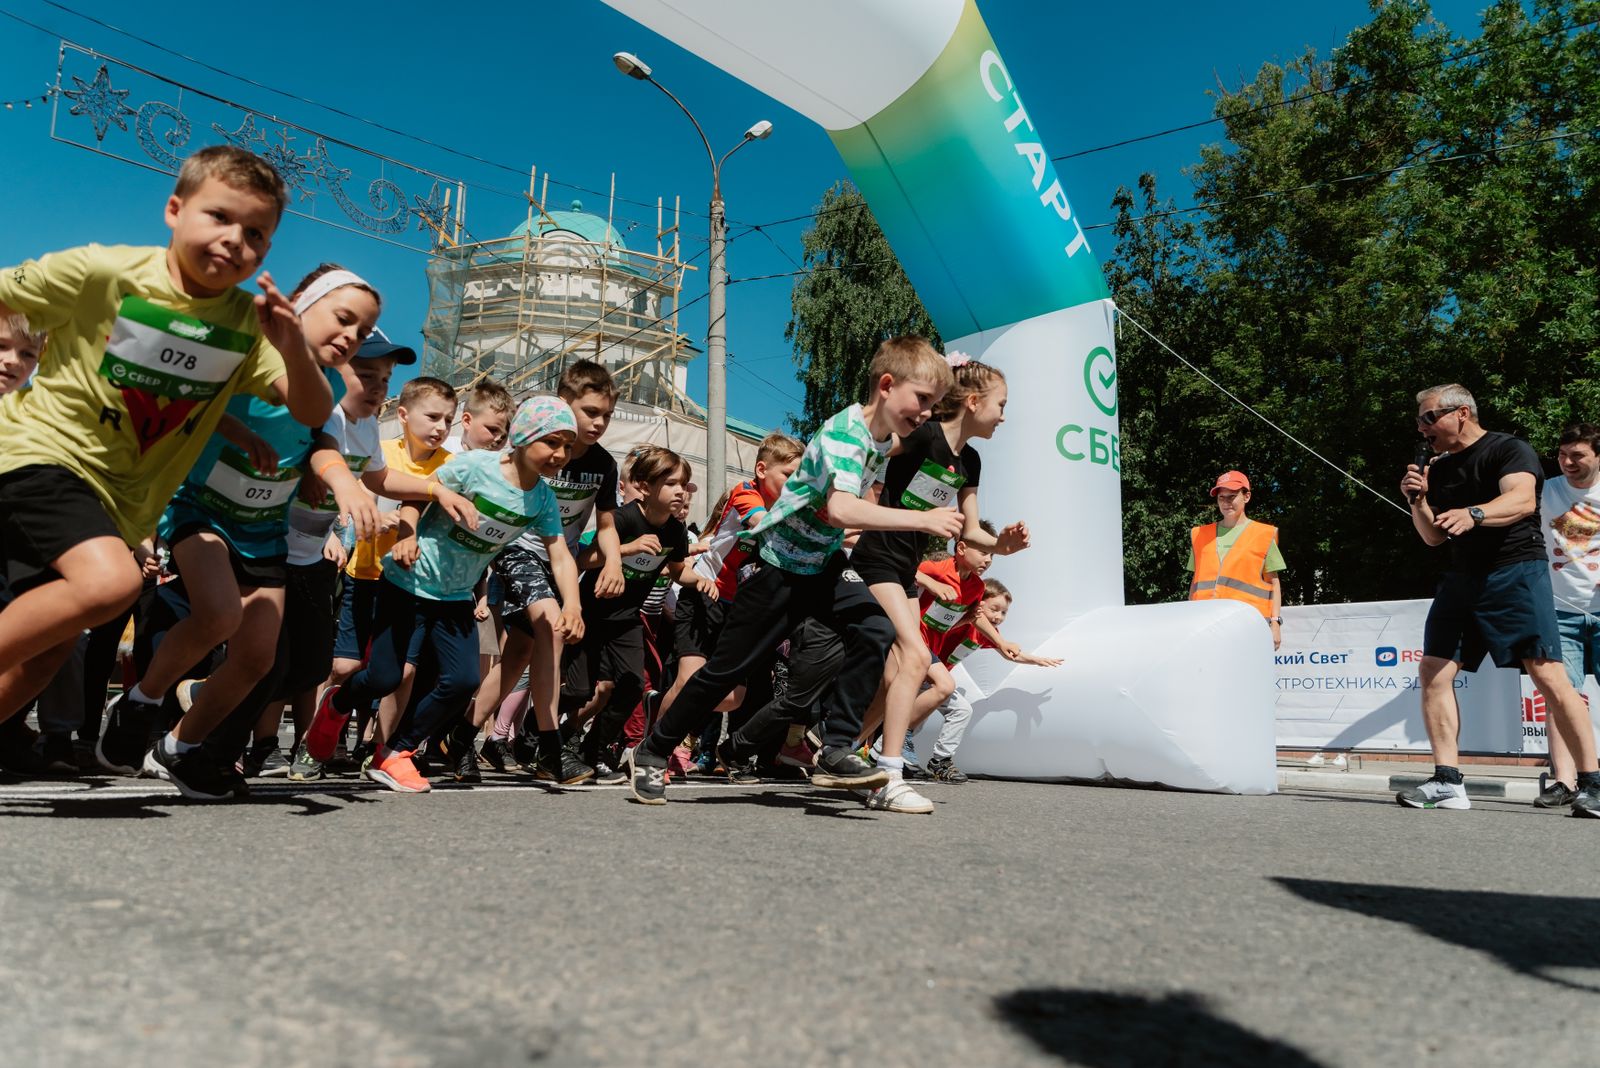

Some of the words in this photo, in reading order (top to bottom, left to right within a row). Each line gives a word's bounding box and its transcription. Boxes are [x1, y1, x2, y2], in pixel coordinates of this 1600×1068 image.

[980, 50, 1091, 258] СТАРТ
[160, 348, 198, 370] 078
[128, 371, 161, 387] СБЕР
[245, 487, 273, 501] 073
[932, 487, 949, 501] 075
[485, 526, 506, 540] 074
[635, 556, 651, 567] 051
[1309, 651, 1349, 665] Свет
[1402, 676, 1468, 691] ЗДЬ!
